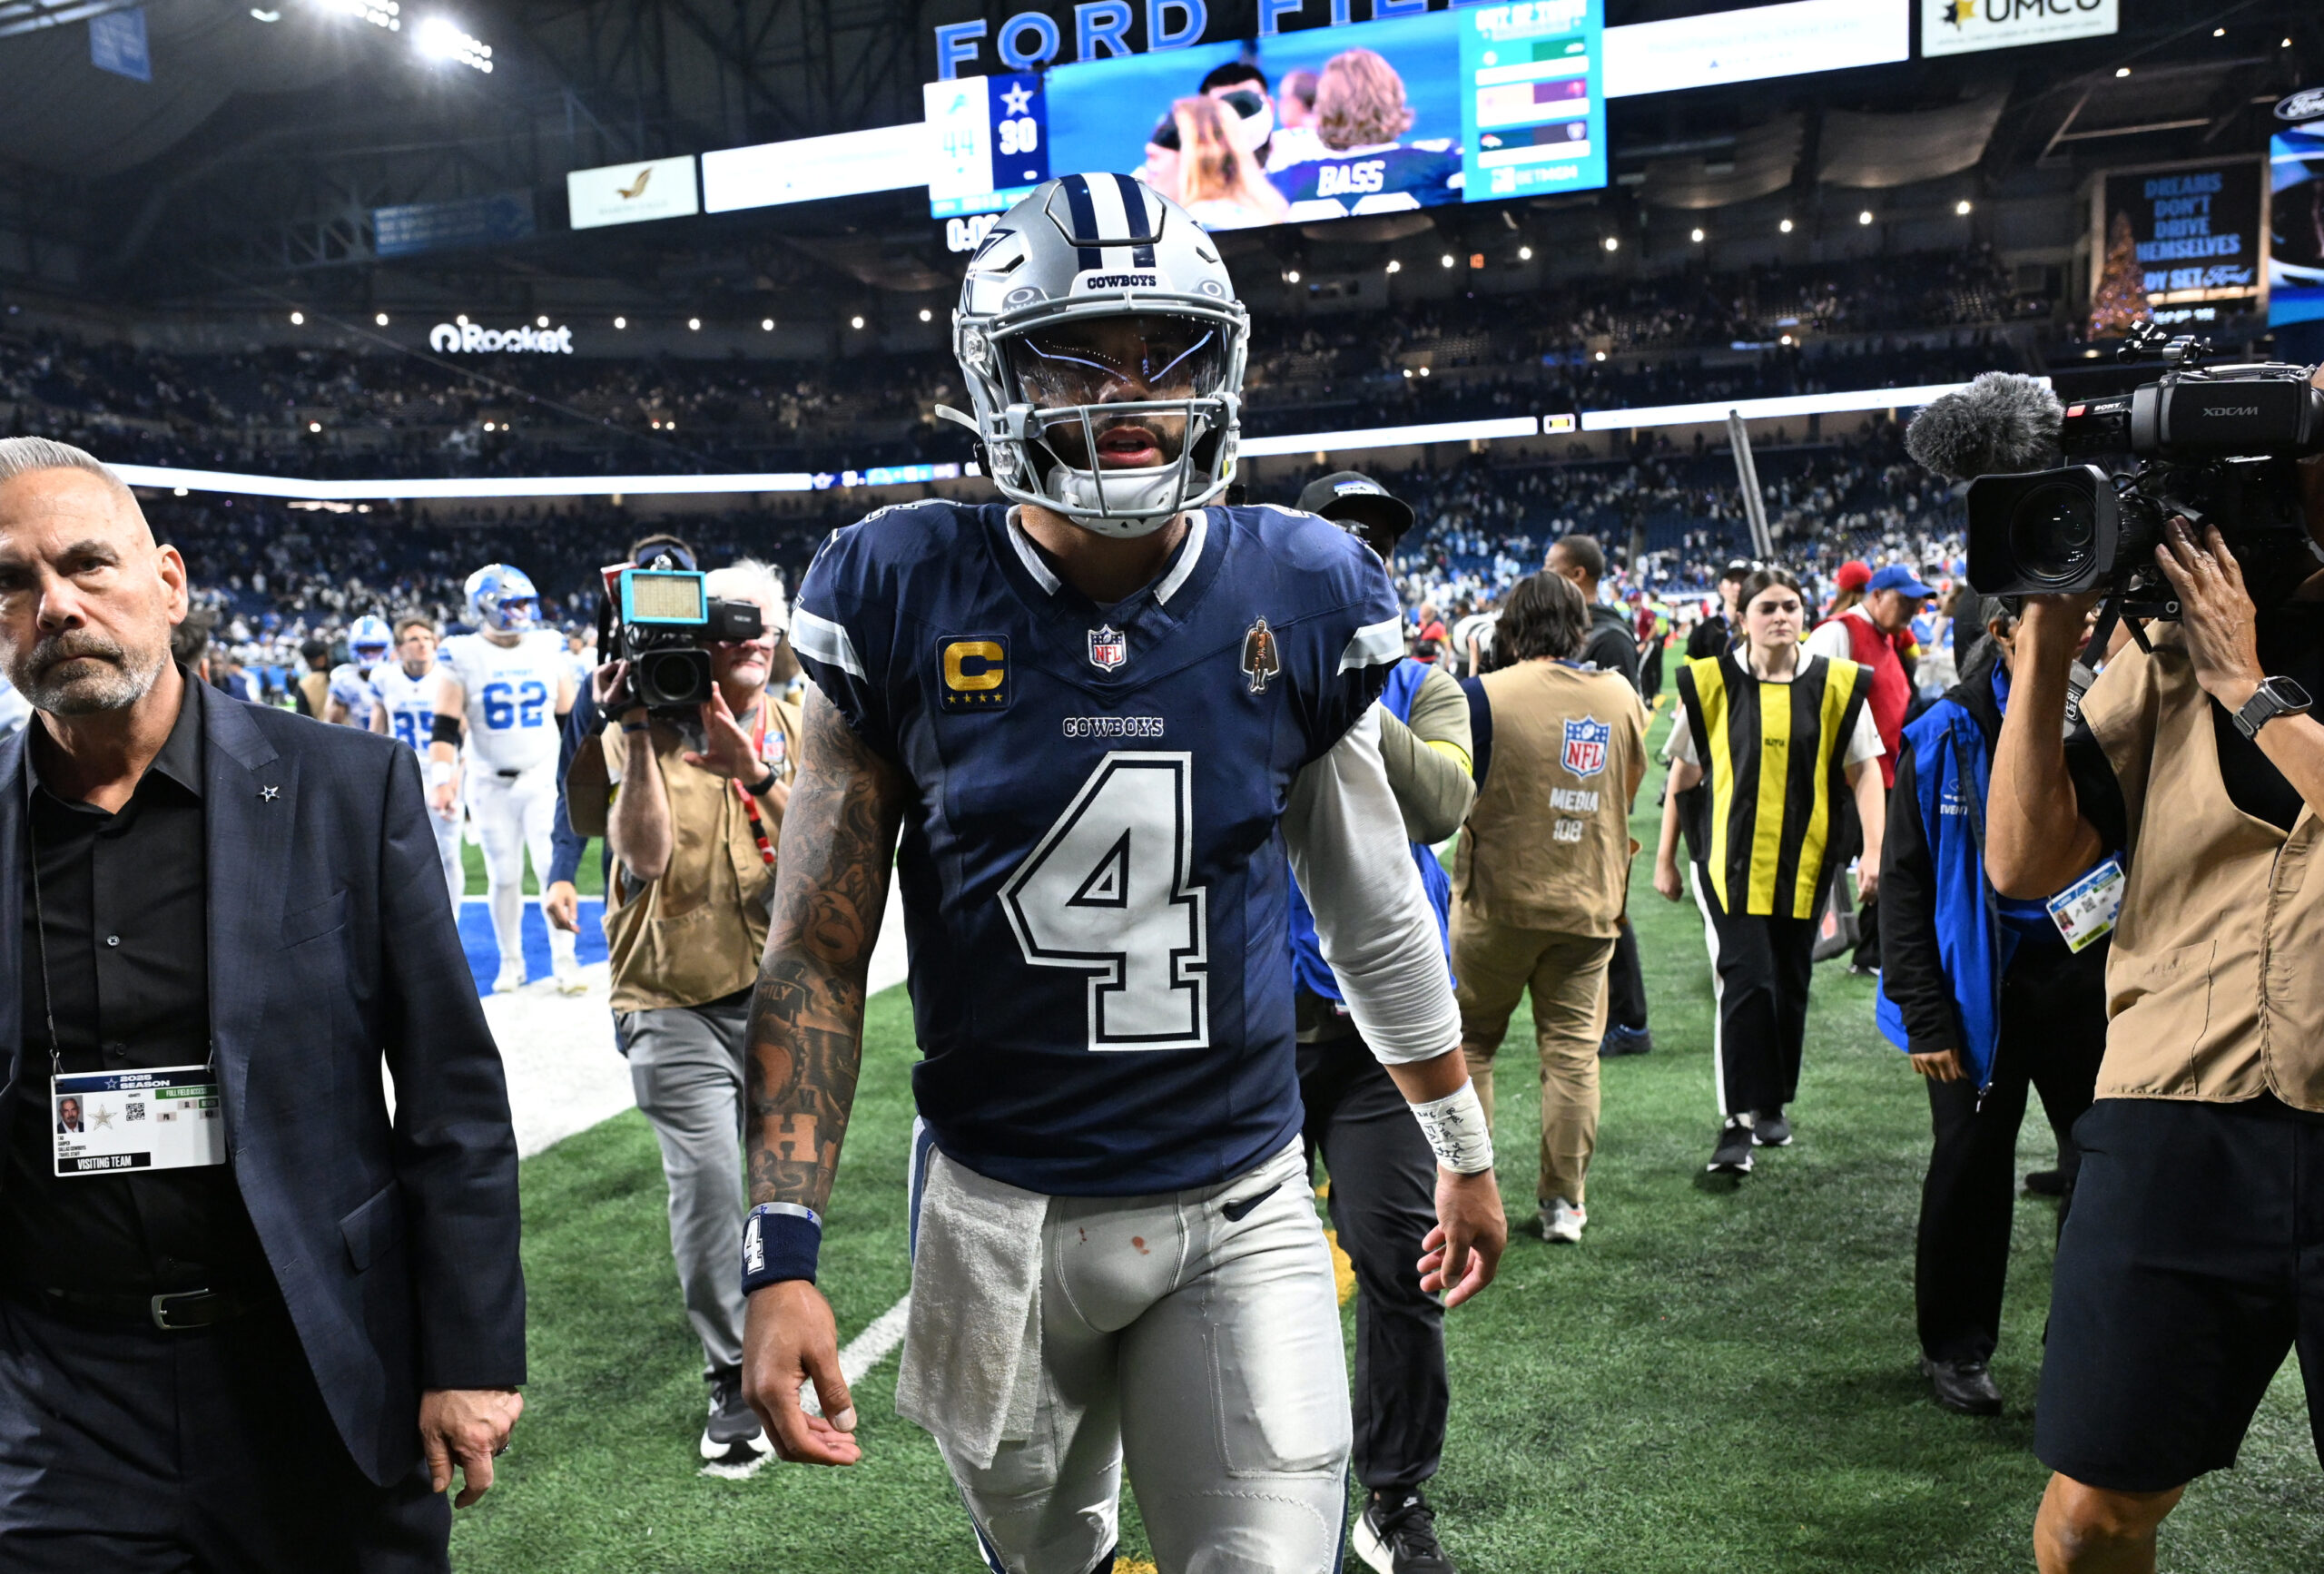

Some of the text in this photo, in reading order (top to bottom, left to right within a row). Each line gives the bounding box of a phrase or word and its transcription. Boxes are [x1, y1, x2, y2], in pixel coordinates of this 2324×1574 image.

[934, 0, 1207, 82] FORD
[942, 128, 974, 158] 44
[999, 118, 1038, 155] 30
[1316, 160, 1386, 197] BASS
[2154, 194, 2212, 219] DON'T
[2154, 216, 2211, 239] DRIVE
[2136, 233, 2241, 262] HEMSELVES
[1087, 275, 1157, 290] COWBOYS
[2170, 267, 2204, 290] SET
[461, 323, 574, 355] Rocket
[2094, 402, 2122, 411] SONY
[2202, 407, 2259, 417] XDCAM
[943, 640, 1005, 693] C
[1095, 645, 1122, 664] NFL
[482, 681, 547, 730] 62
[1062, 717, 1164, 737] COWBOYS
[1568, 741, 1601, 770] NFL
[1549, 787, 1600, 812] MEDIA
[1552, 819, 1582, 842] 108
[997, 751, 1210, 1051] 4
[120, 1074, 153, 1083] 2025
[120, 1080, 171, 1089] SEASON
[763, 1112, 818, 1163] H
[77, 1156, 132, 1170] VISITING TEAM
[743, 1215, 764, 1275] 4
